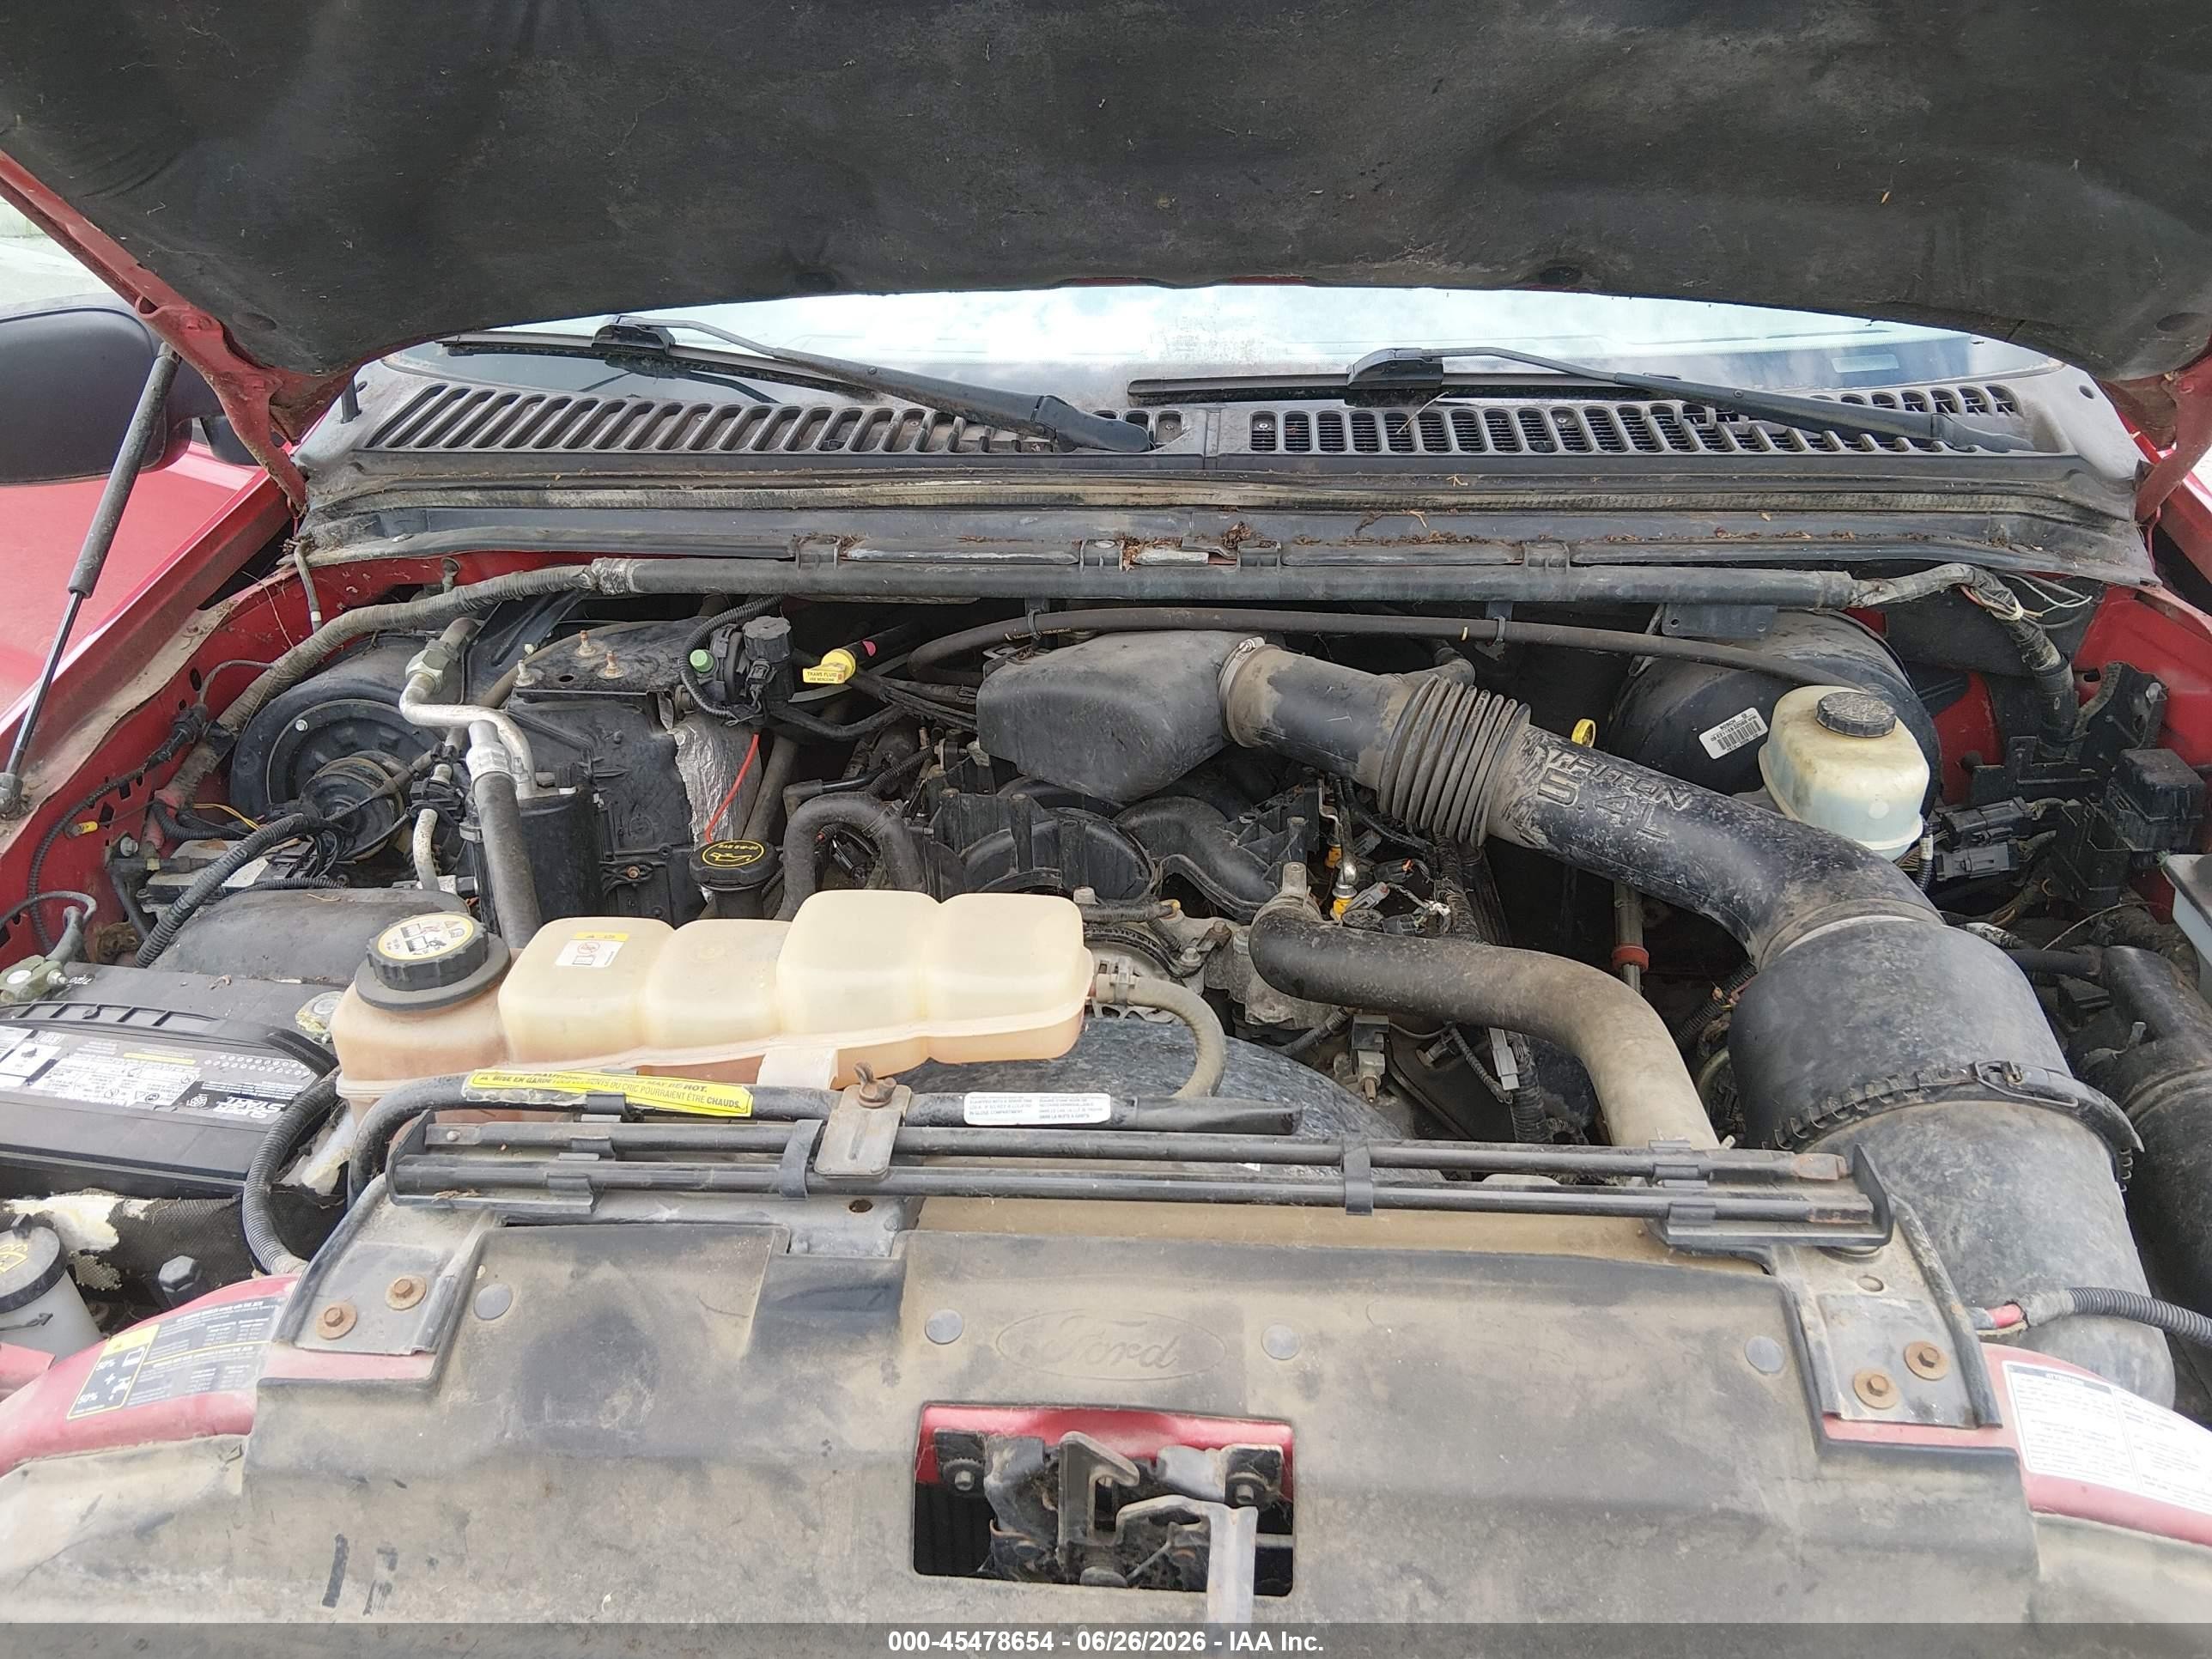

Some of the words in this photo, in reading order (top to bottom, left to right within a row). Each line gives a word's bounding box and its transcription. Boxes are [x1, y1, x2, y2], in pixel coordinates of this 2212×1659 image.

[1719, 720, 1735, 730] BOSCH
[1550, 746, 1692, 811] TRITON
[1536, 766, 1669, 842] 5.4L
[212, 1101, 269, 1119] SUPER
[622, 1084, 639, 1092] CRIC
[640, 1085, 685, 1100] POURRAIENT
[687, 1091, 705, 1103] ÊTRE
[1033, 1315, 1181, 1370] Ford
